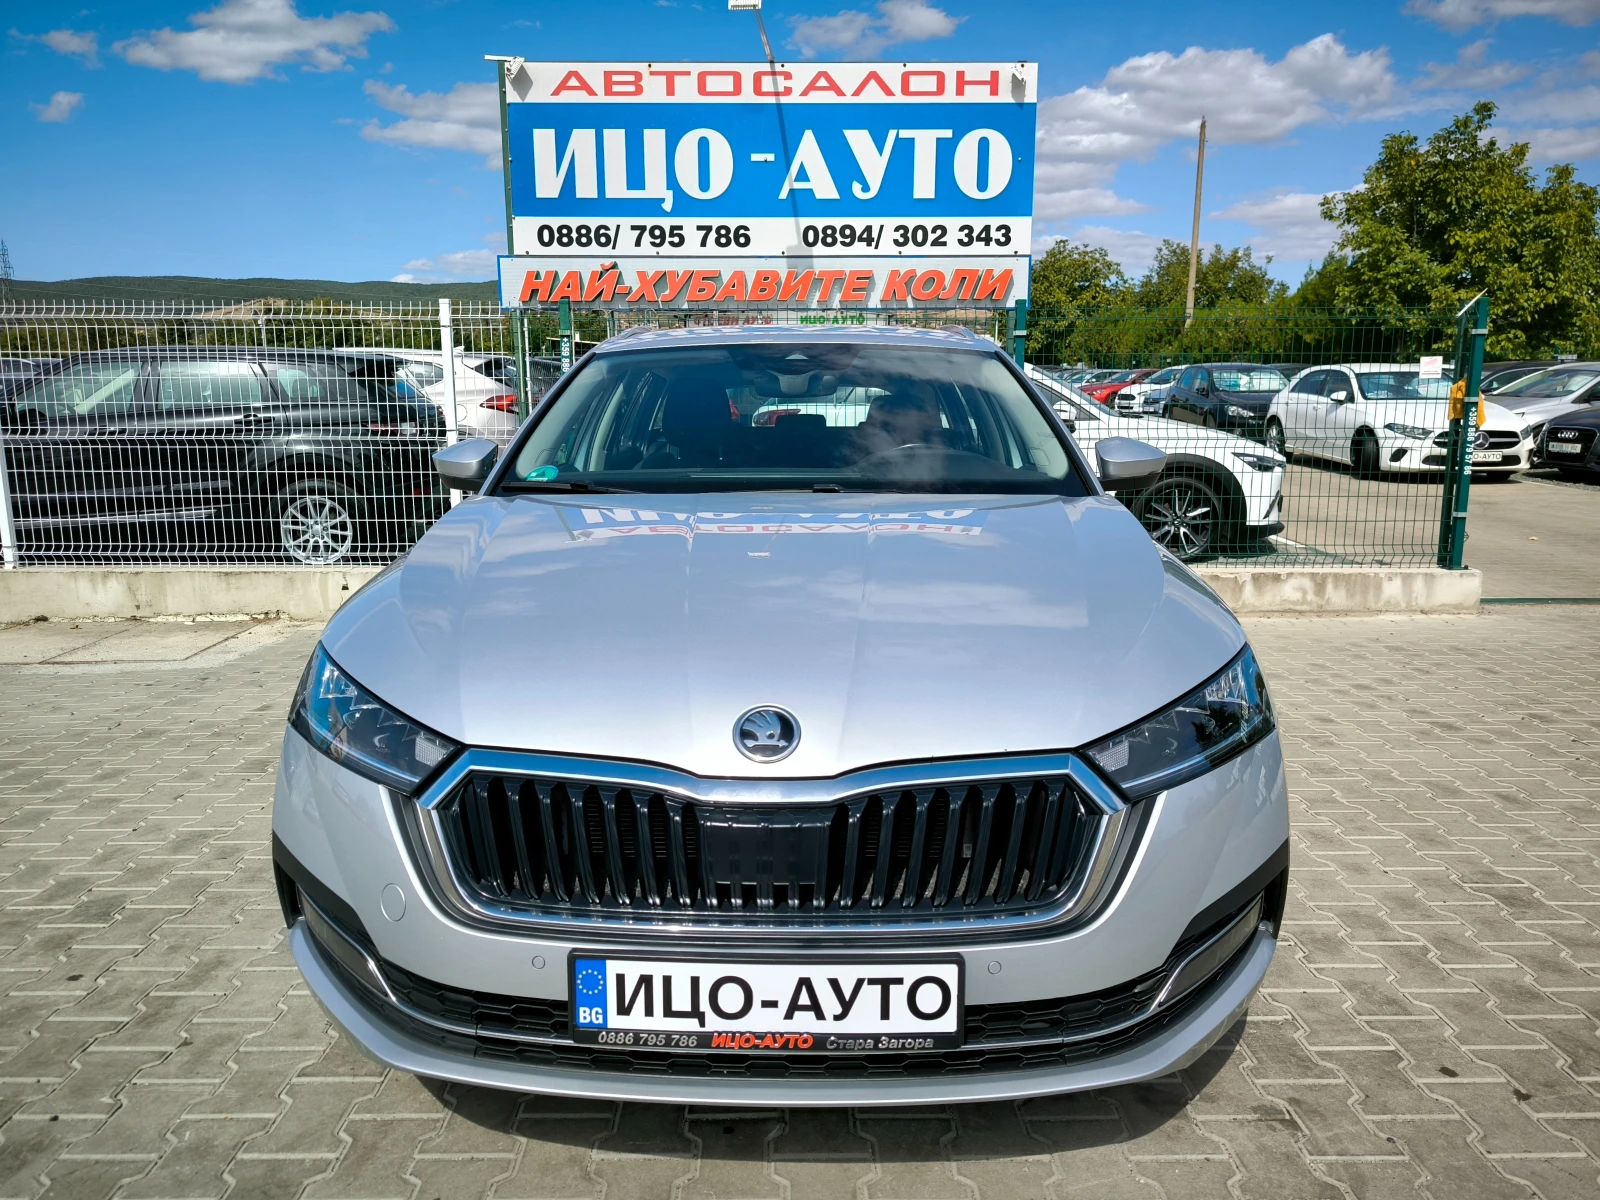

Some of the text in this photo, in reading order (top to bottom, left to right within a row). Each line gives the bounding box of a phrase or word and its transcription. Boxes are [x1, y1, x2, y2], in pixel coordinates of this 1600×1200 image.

[550, 70, 1000, 97] АВТОСАЛОН
[536, 224, 752, 250] 0886/ 795 786
[802, 224, 1012, 250] 0894/ 302 343
[518, 261, 1014, 302] НАЙ-ХУБАВИТЕ КОЛИ
[615, 972, 952, 1028] ИЦО-АУТО
[578, 1006, 604, 1024] BG
[597, 1031, 935, 1050] 0886 795 786 ИЦО-АУТО Стара Загора
